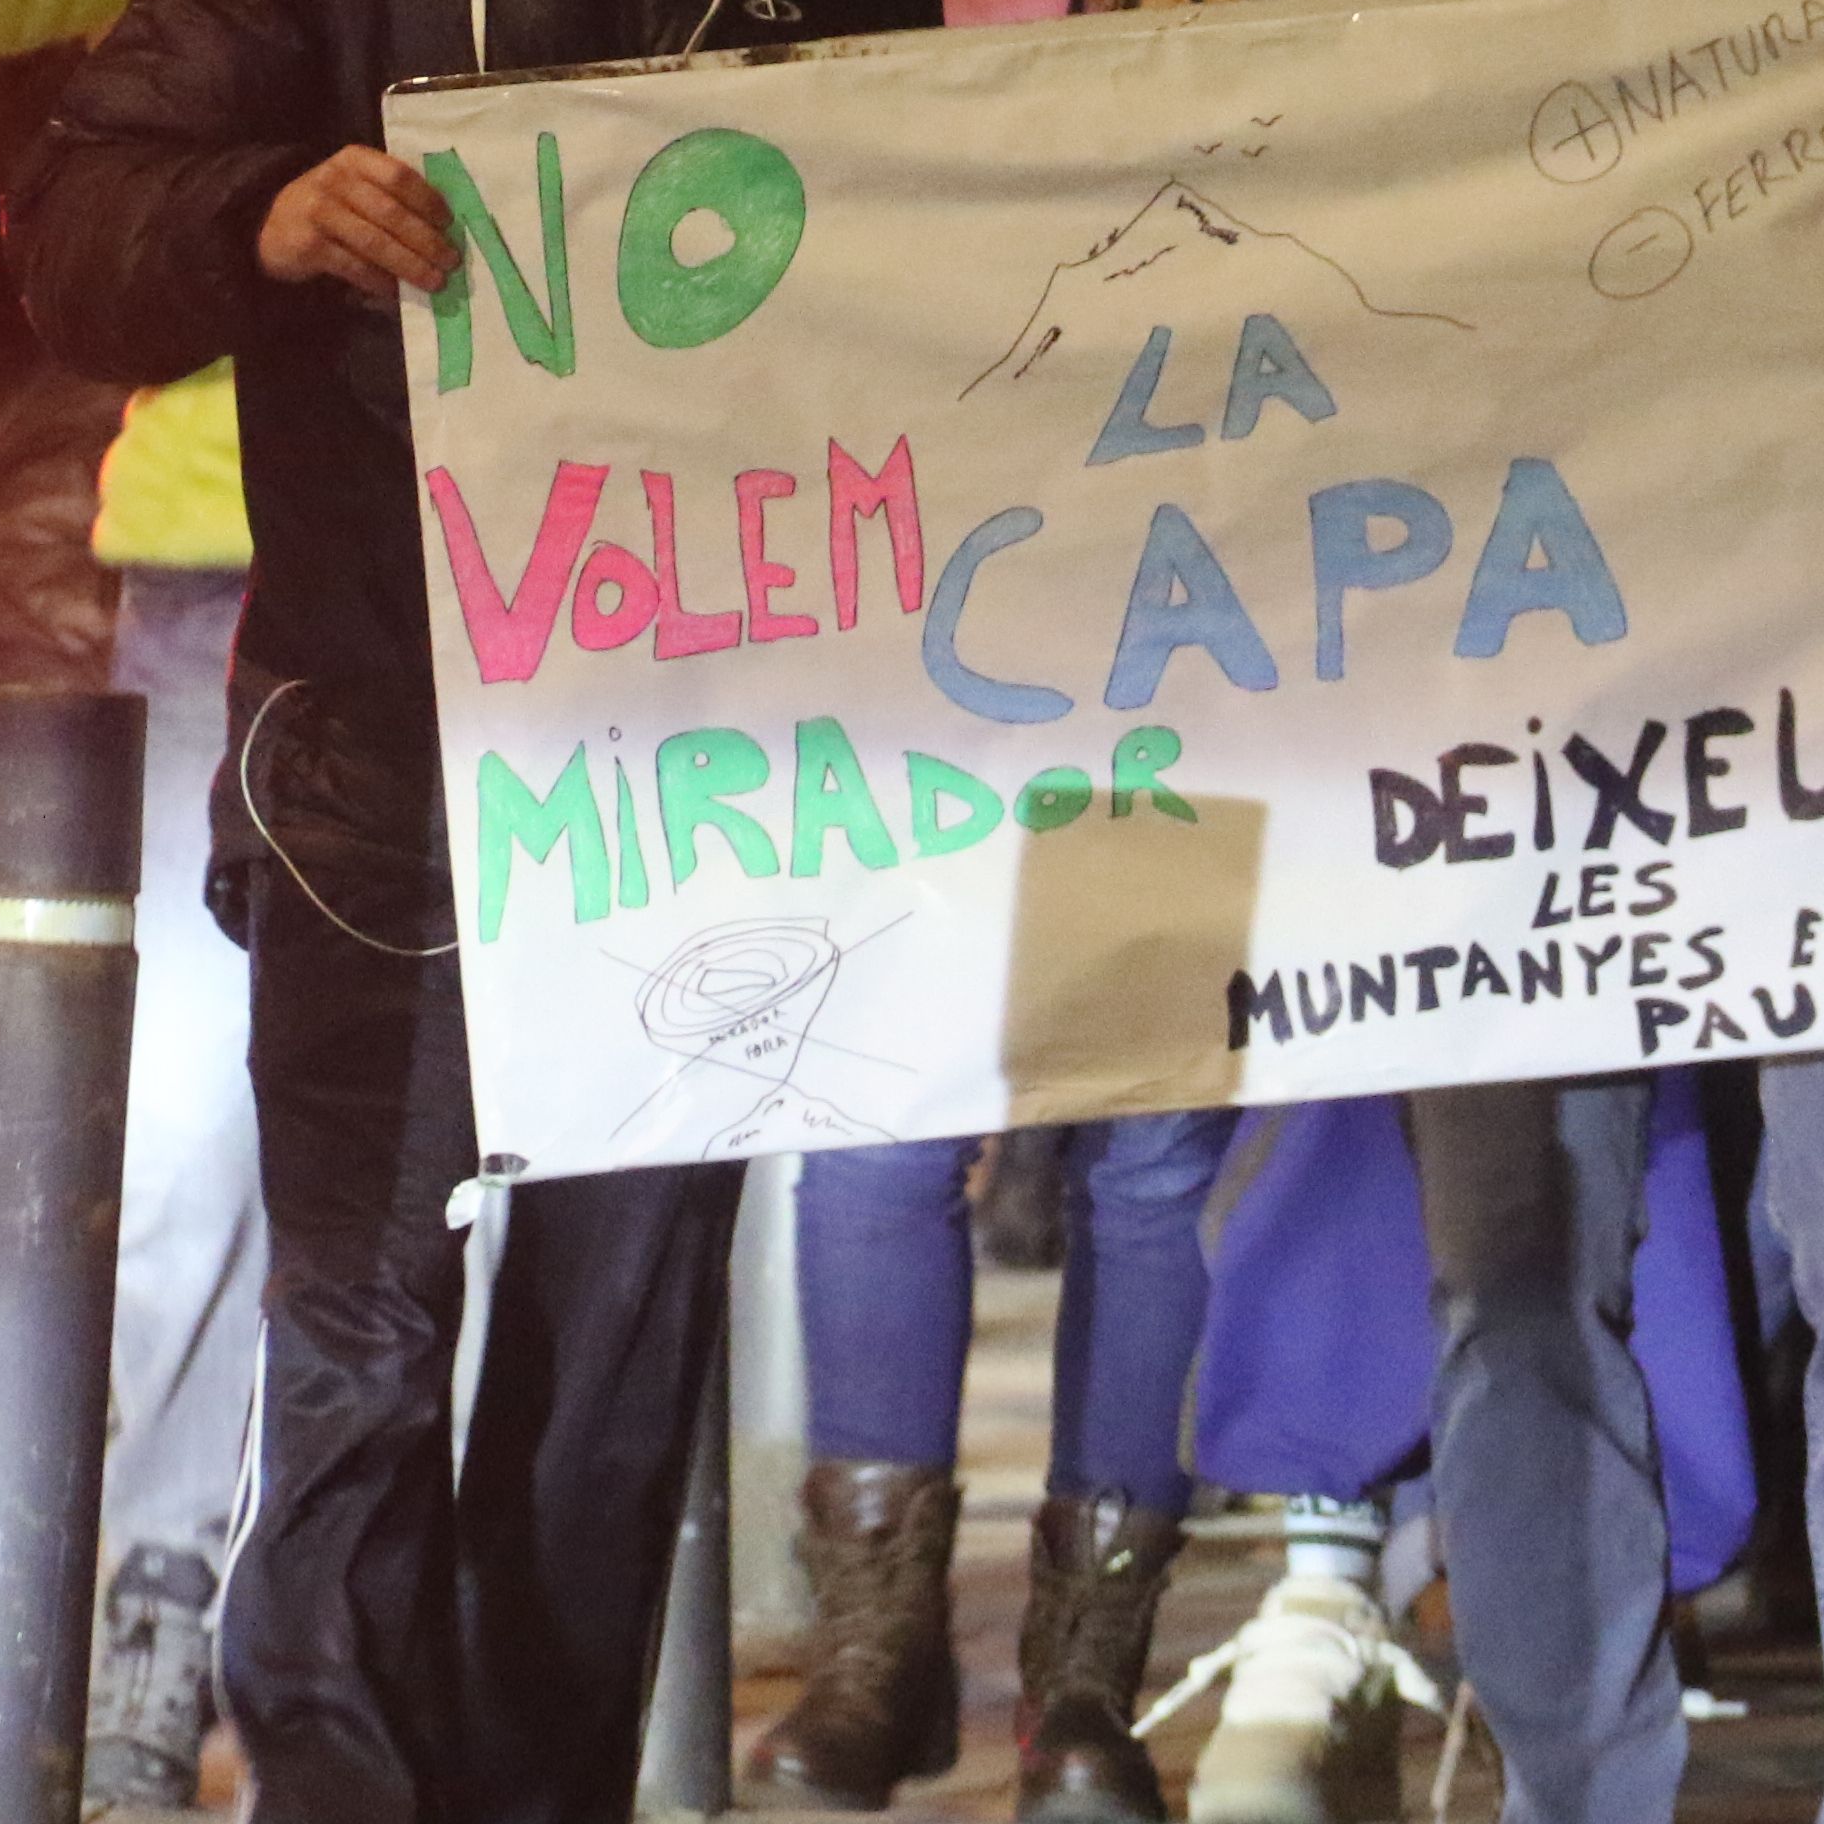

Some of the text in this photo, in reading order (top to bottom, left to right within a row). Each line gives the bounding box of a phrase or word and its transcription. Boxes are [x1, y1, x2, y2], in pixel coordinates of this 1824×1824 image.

[422, 127, 807, 394] NO
[1085, 313, 1338, 467] LA
[921, 457, 1629, 725] CAPA
[1530, 861, 1681, 929] LES
[1227, 924, 1729, 1052] MUNTANYES
[1634, 982, 1818, 1058] PAU
